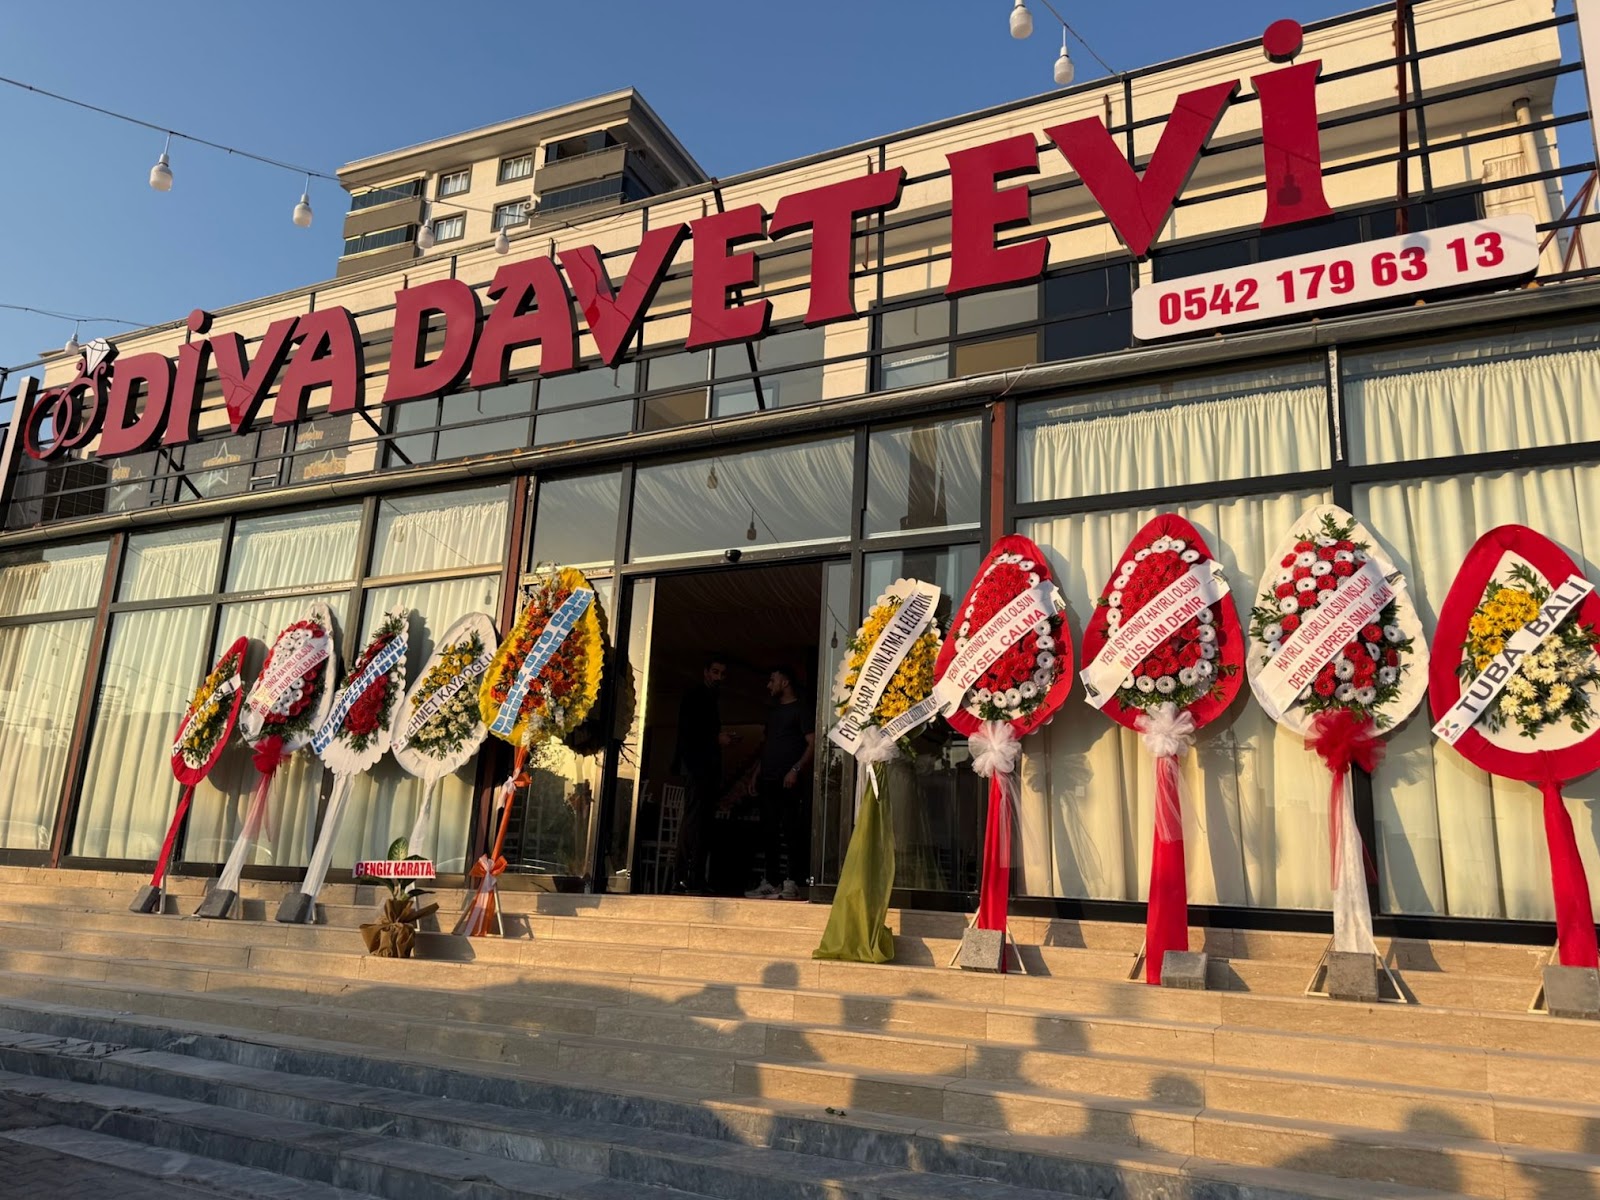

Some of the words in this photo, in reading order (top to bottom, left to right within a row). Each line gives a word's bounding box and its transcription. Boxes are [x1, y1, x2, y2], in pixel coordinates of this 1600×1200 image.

[96, 309, 364, 457] DİVA
[382, 165, 906, 403] DAVET
[945, 19, 1335, 298] EVİ
[1159, 278, 1259, 326] 0542
[1277, 259, 1355, 304] 179
[1371, 246, 1428, 288] 63
[1447, 231, 1504, 273] 13
[276, 658, 297, 679] HAYIRLI
[295, 643, 315, 660] OLSUN
[524, 630, 553, 668] OTO
[550, 589, 585, 627] CAM
[947, 661, 959, 682] YENİ
[984, 612, 1012, 640] HAYIRLI
[1008, 593, 1035, 617] OLSUN
[1100, 644, 1118, 666] YENİ
[1143, 592, 1177, 621] HAYIRLI
[1172, 575, 1201, 598] OLSUN
[1120, 624, 1170, 670] MÜSLÜM
[1165, 596, 1206, 628] DEMİR
[1274, 641, 1304, 672] HAYIRLI
[1323, 593, 1351, 619] OLSUN
[1288, 654, 1320, 690] DEVRAN
[1316, 622, 1355, 659] EXPRESS
[1370, 585, 1394, 608] ASLAN
[1456, 648, 1526, 714] TUBA
[1525, 579, 1588, 638] BALİ
[259, 689, 279, 716] MEET
[278, 676, 293, 691] NUR
[839, 715, 861, 742] EYÜP
[853, 685, 875, 719] YAŞAR
[864, 631, 907, 687] AYDINLATMA
[958, 646, 1002, 689] VEYSEL
